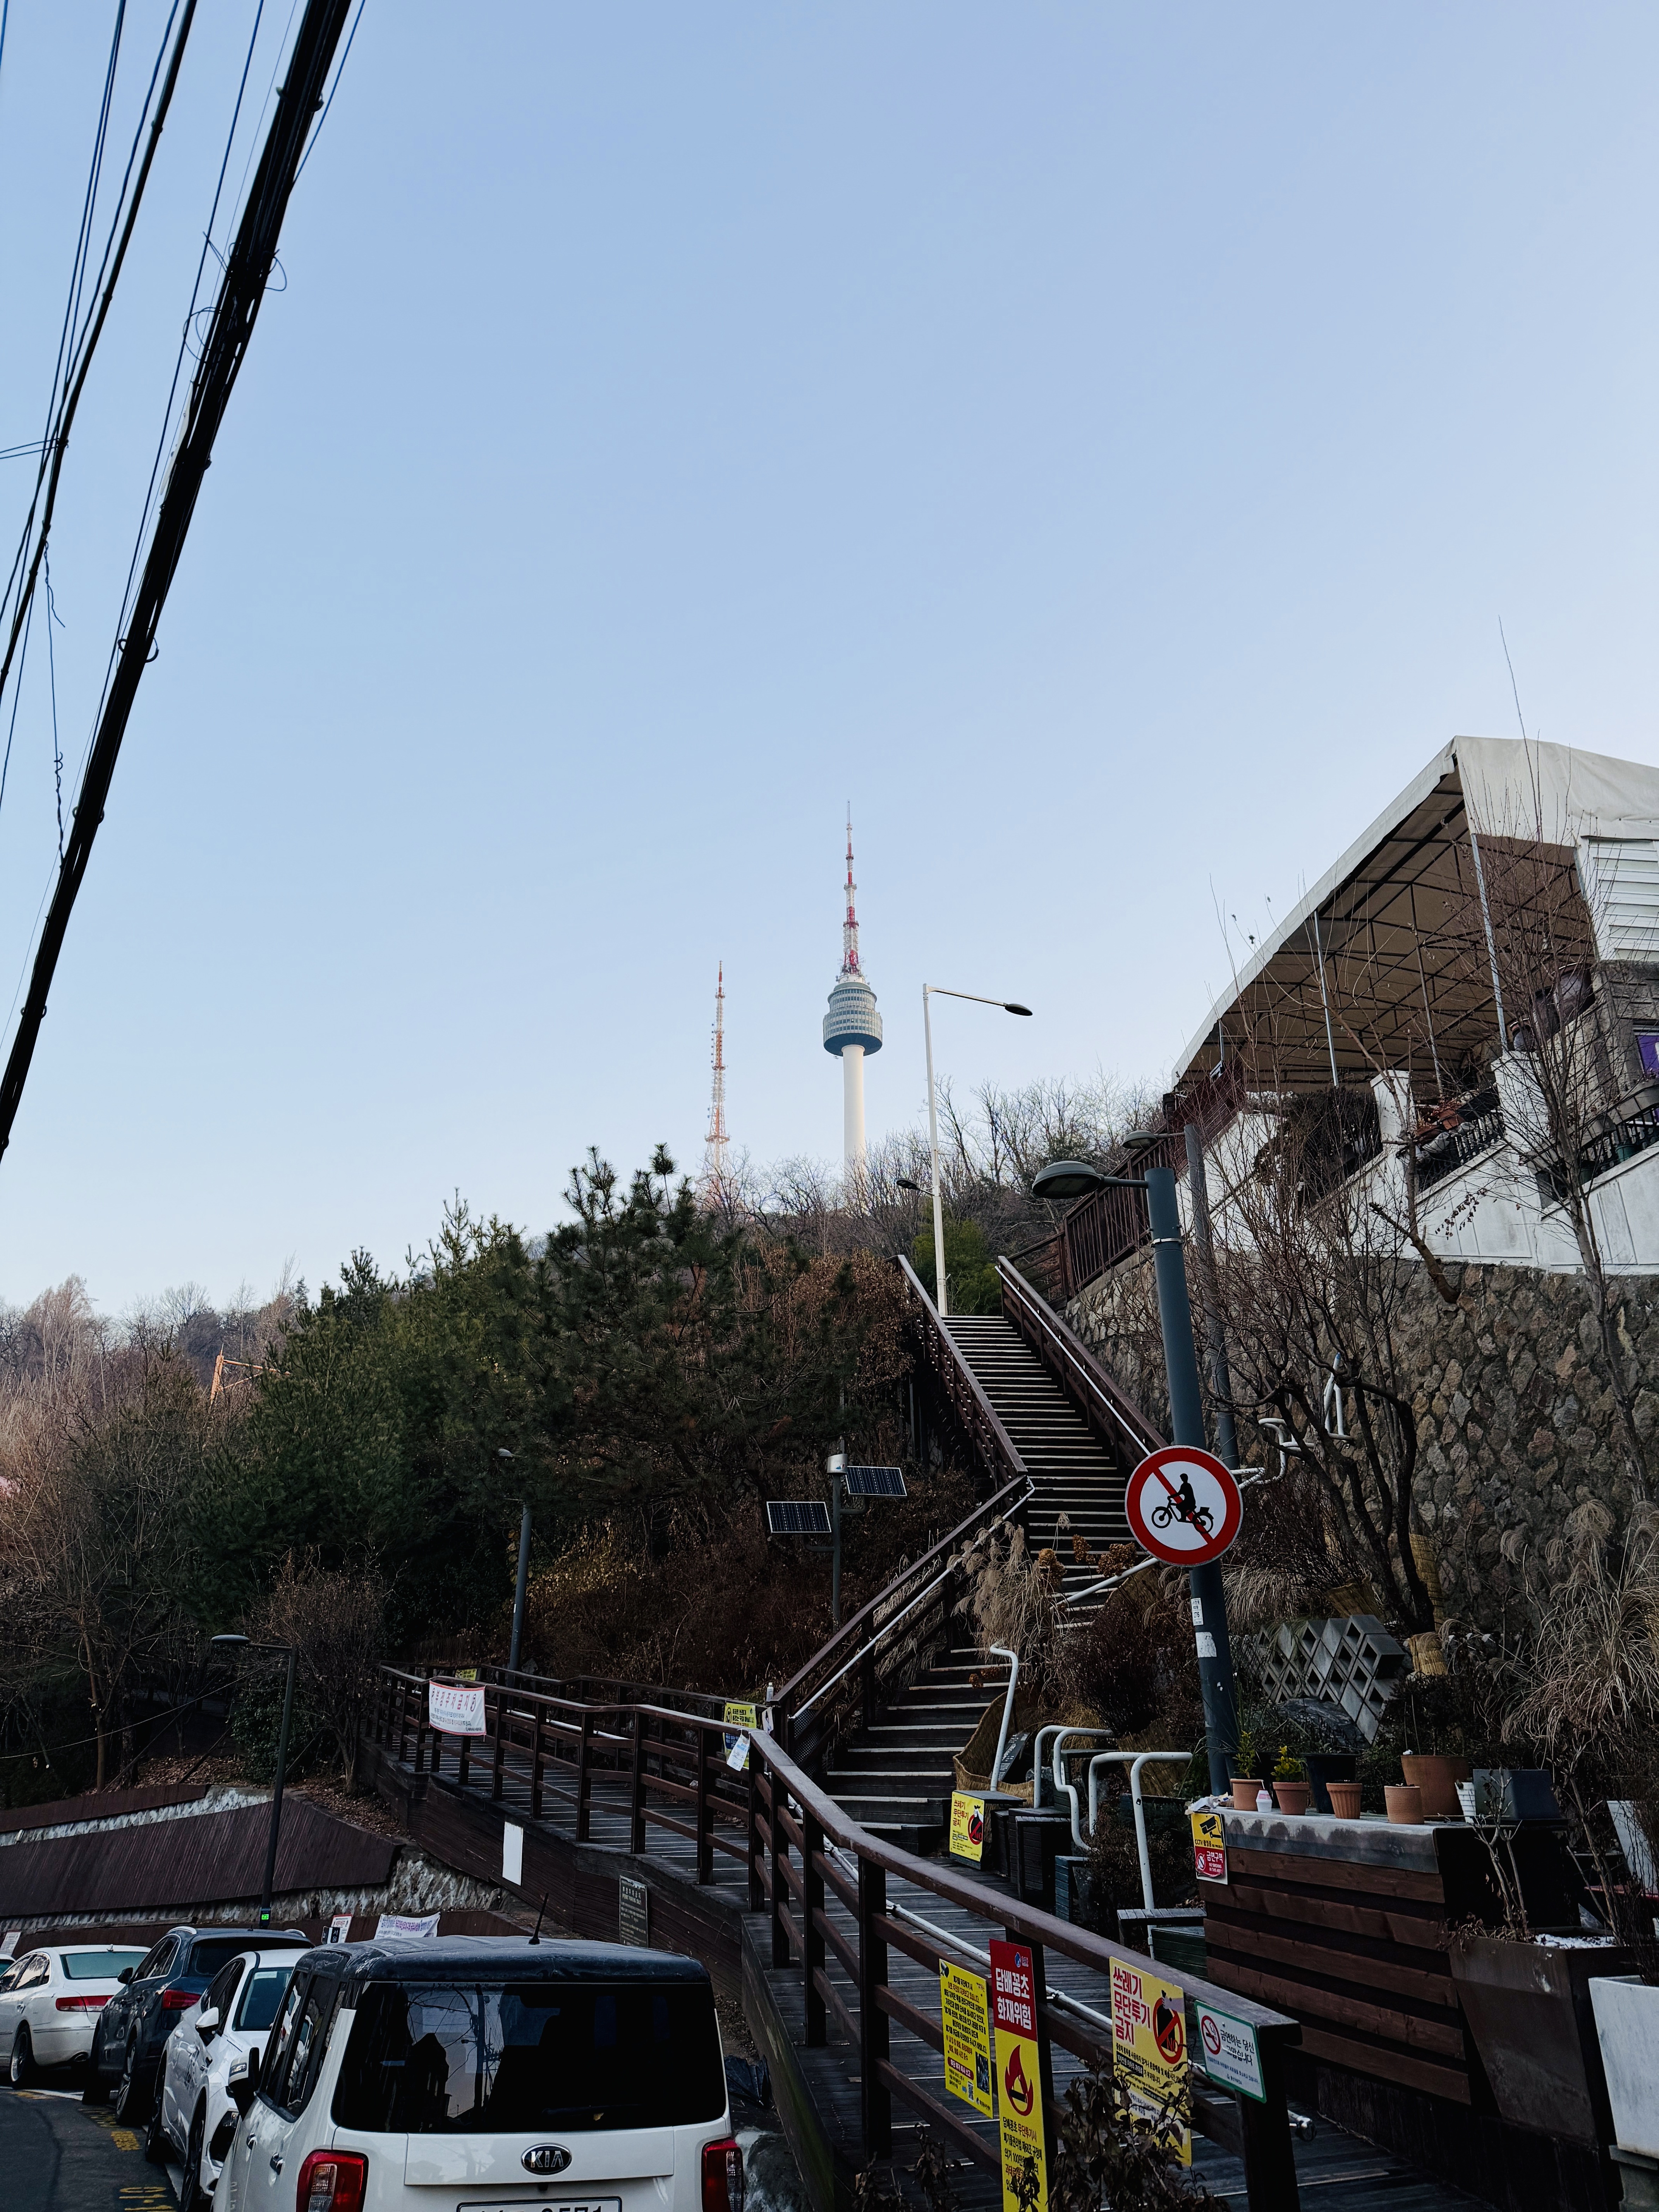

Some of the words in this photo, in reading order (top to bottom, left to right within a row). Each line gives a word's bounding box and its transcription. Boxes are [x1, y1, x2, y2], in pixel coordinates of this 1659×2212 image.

[953, 1808, 969, 1820] 무단투기
[954, 1800, 965, 1810] 쓰레기
[953, 1818, 961, 1827] 금지
[1206, 1851, 1223, 1863] 금연구역
[996, 1968, 1030, 1999] 담배꽁초
[1113, 1966, 1142, 1999] 쓰레기
[997, 1996, 1032, 2030] 화재위험
[1114, 1991, 1151, 2028] 무단투기
[1115, 2015, 1135, 2045] 금지
[1167, 2037, 1178, 2052] NO
[1220, 2030, 1241, 2048] 금연하는
[1243, 2039, 1254, 2054] 당신
[1226, 2045, 1253, 2066] 고맙습니다
[1003, 2117, 1018, 2132] 담배꽁초
[531, 2150, 563, 2167] KIA
